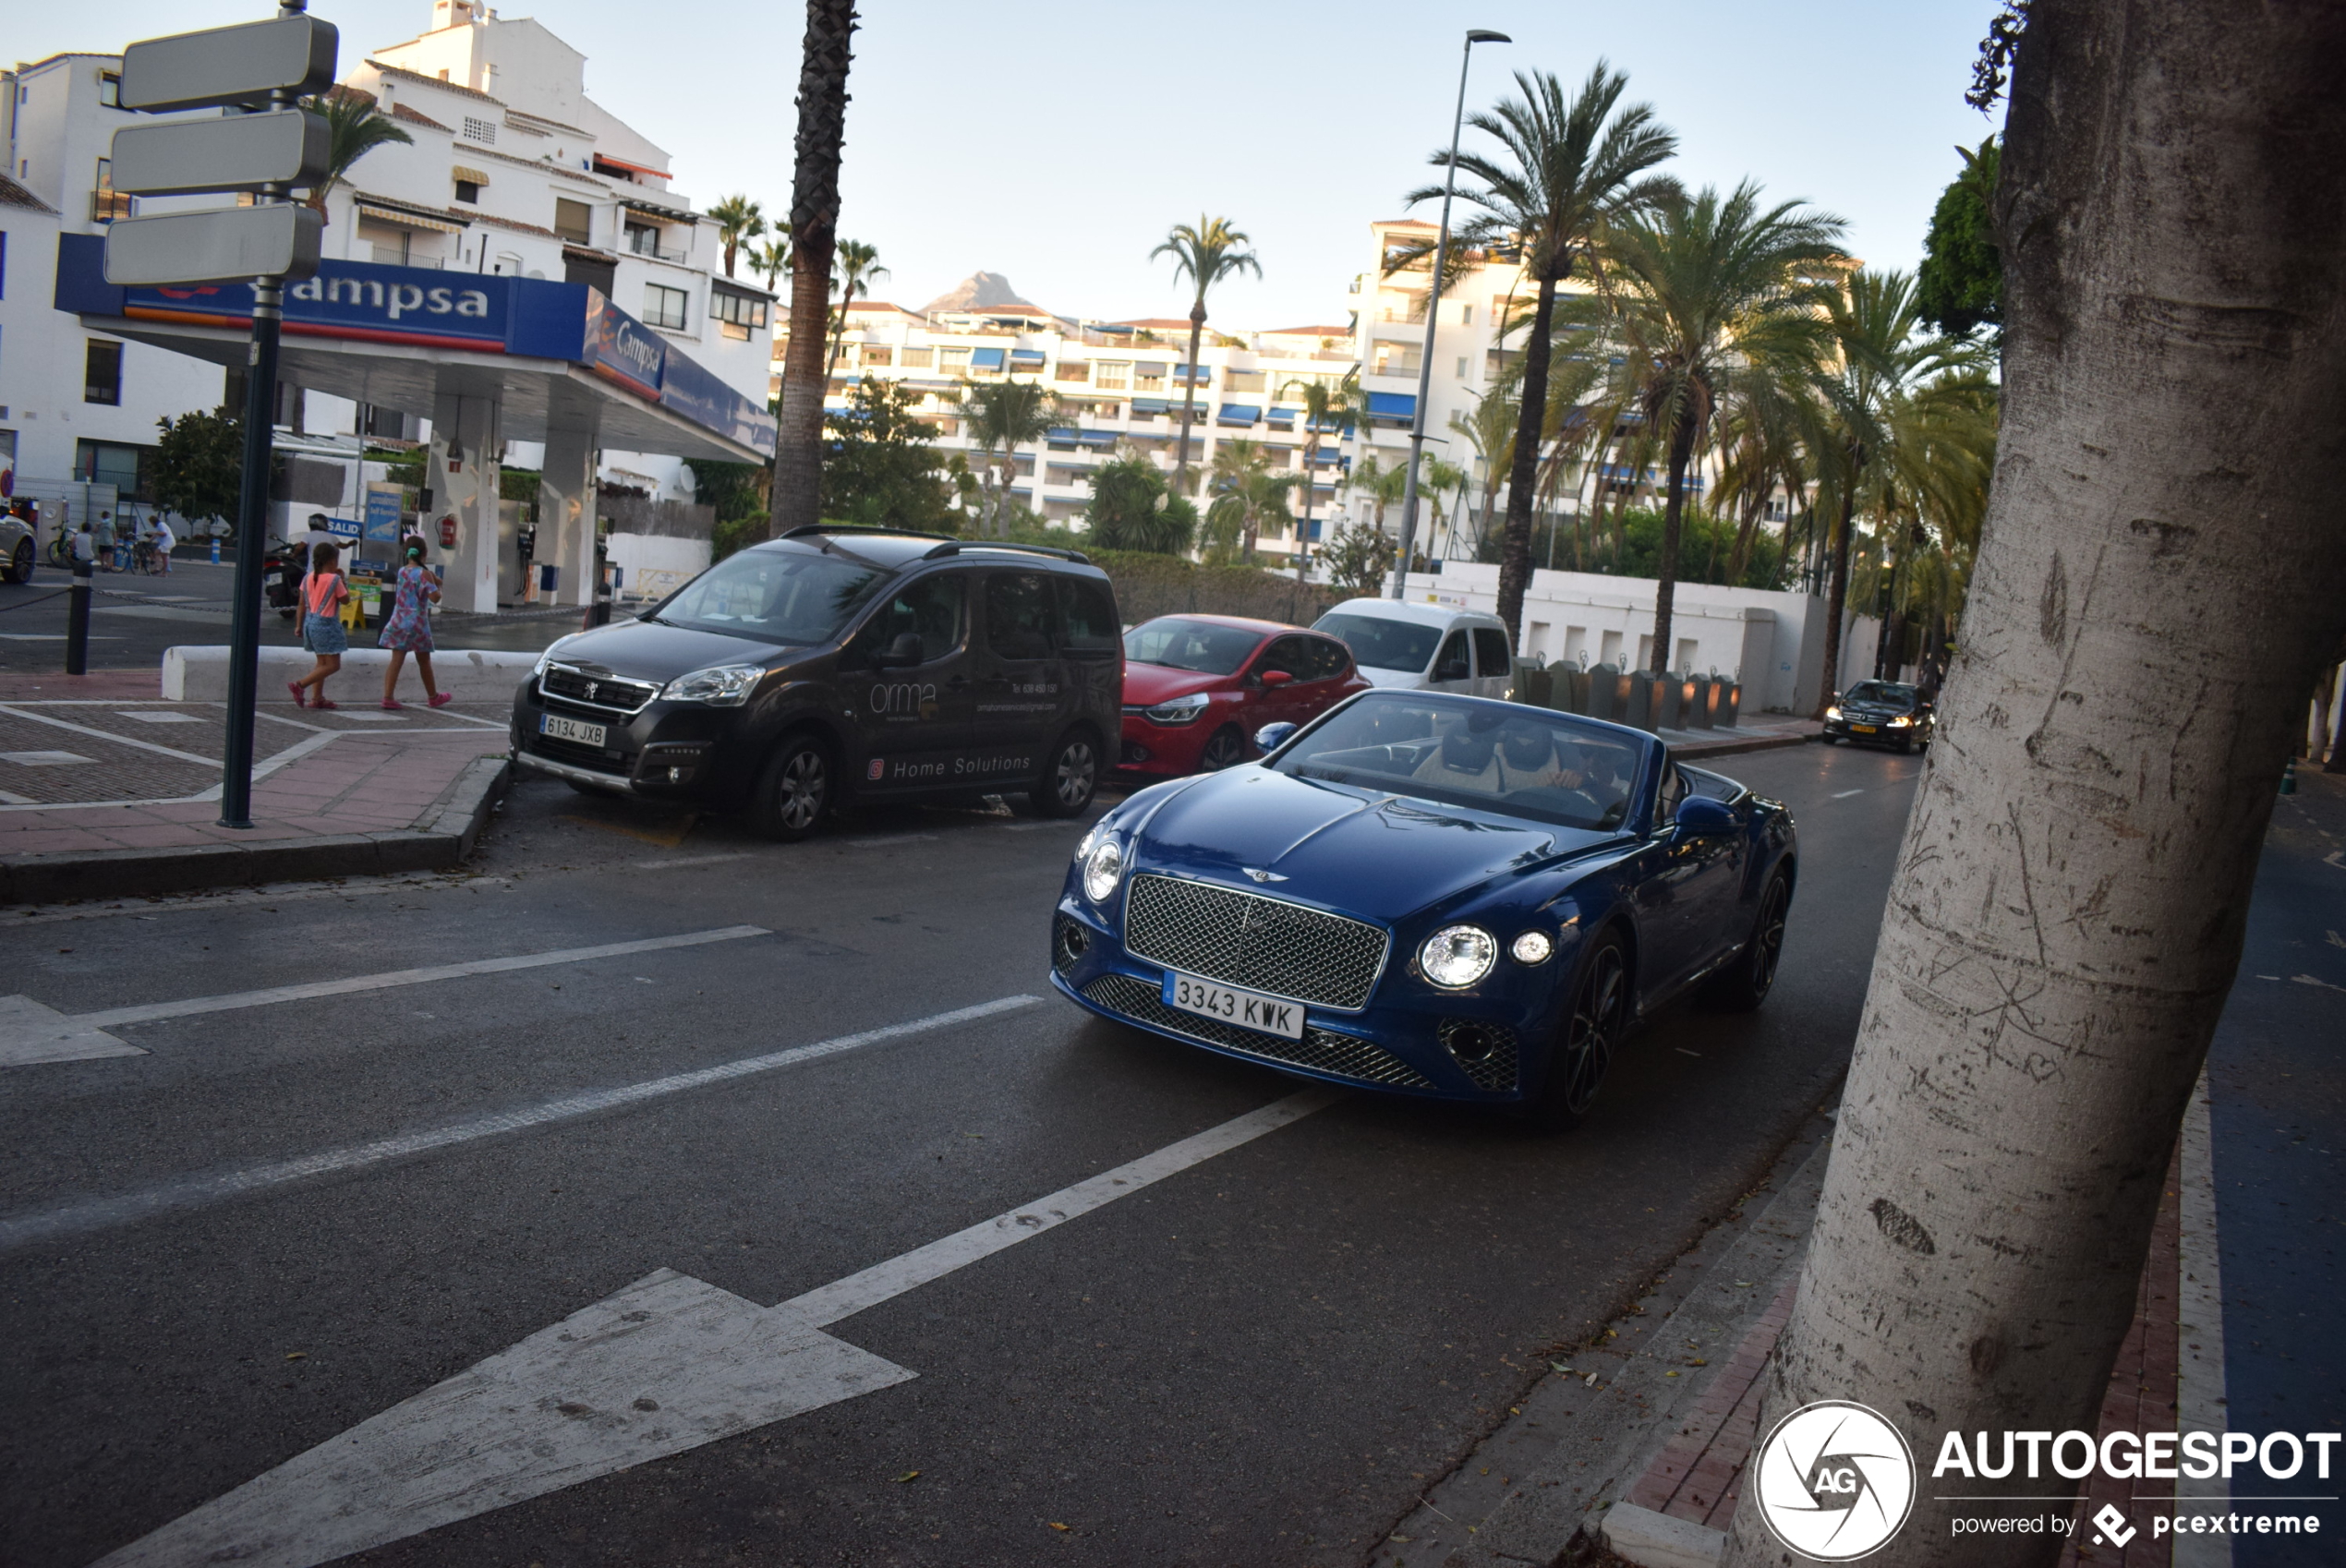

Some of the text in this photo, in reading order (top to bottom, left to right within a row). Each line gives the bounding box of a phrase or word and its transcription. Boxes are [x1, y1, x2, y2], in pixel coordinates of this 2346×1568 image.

[247, 276, 488, 320] ampsa
[617, 320, 659, 373] Campsa
[871, 683, 936, 713] orma
[548, 718, 602, 743] 6134 JXB
[894, 755, 1030, 778] Home Solutions
[1178, 981, 1292, 1031] 3343 KWK
